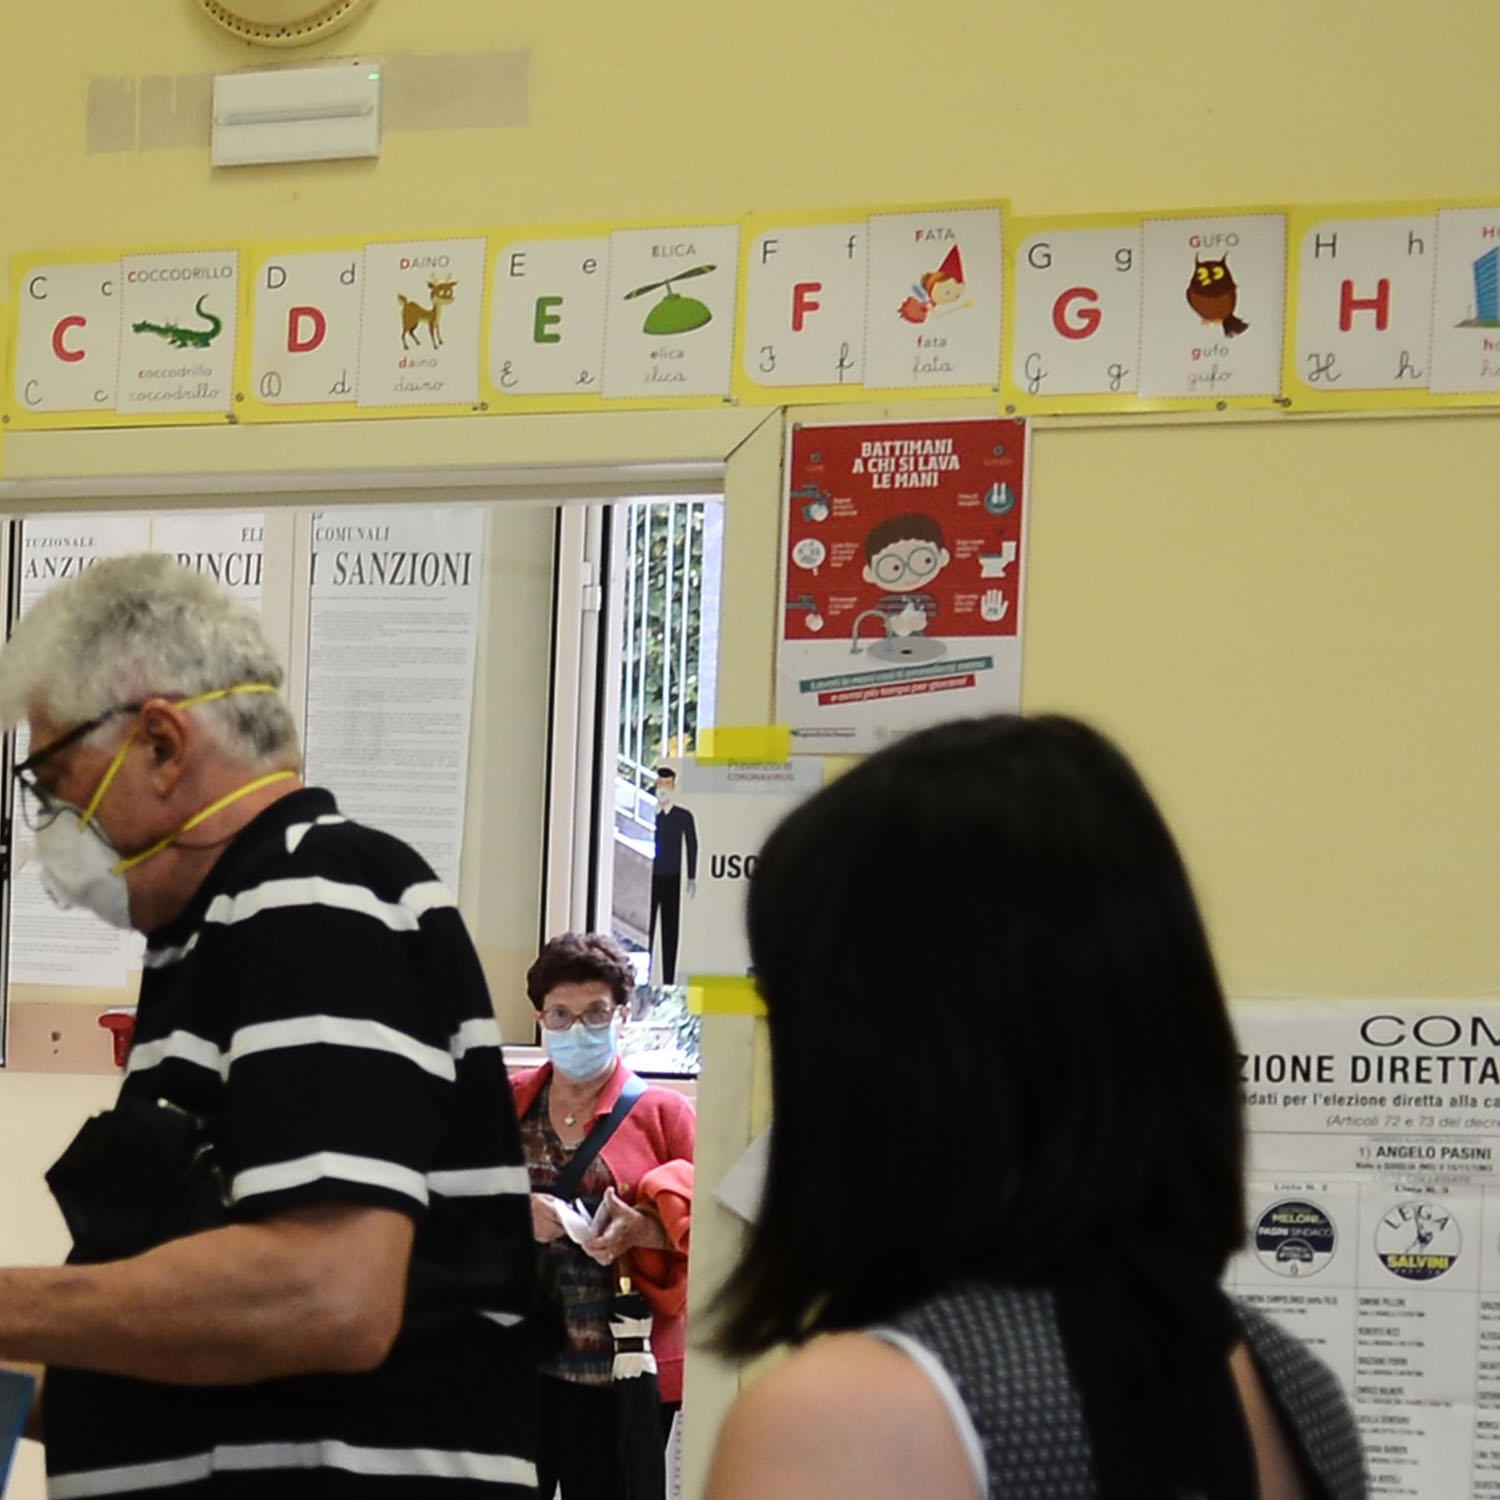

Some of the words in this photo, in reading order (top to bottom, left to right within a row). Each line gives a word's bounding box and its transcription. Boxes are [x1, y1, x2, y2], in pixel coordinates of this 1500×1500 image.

[915, 228, 955, 243] FATA
[1189, 233, 1239, 249] GUFO
[1314, 234, 1337, 259] H
[1407, 231, 1424, 256] h
[652, 244, 697, 259] ELICA
[762, 240, 778, 264] F
[845, 235, 856, 260] f
[1028, 243, 1052, 269] G
[1114, 247, 1133, 271] g
[400, 255, 451, 270] DAINO
[509, 253, 526, 278] E
[582, 257, 597, 274] e
[127, 266, 232, 284] COCCODRILLO
[267, 266, 286, 289] D
[340, 264, 355, 286] d
[29, 276, 48, 300] C
[101, 280, 113, 297] c
[792, 282, 821, 332] F
[1052, 286, 1101, 340] G
[1339, 278, 1390, 332] H
[287, 306, 326, 353] D
[533, 296, 563, 344] E
[52, 315, 87, 362] C
[917, 335, 947, 349] fata
[651, 347, 684, 360] elica
[1192, 343, 1229, 359] gufo
[138, 365, 212, 379] coccodrillo
[399, 356, 438, 370] daino
[861, 439, 953, 458] BATTIMANI
[852, 459, 864, 474] A
[868, 458, 895, 473] CHI
[900, 457, 915, 471] SI
[918, 455, 960, 470] LAVA
[872, 475, 891, 489] LE
[895, 472, 939, 488] MANI
[316, 527, 390, 542] COMUNALI
[333, 551, 472, 587] SANZIONI
[1351, 1055, 1500, 1085] DIRETTA
[1283, 1095, 1306, 1108] per
[1313, 1093, 1387, 1106] l'elezione
[1392, 1093, 1443, 1108] diretta
[1449, 1094, 1477, 1107] alla
[1384, 1115, 1401, 1126] 72
[1406, 1118, 1414, 1127] e
[1418, 1115, 1433, 1128] 73
[1439, 1116, 1459, 1128] del
[1376, 1146, 1436, 1160] ANGELO
[1441, 1147, 1492, 1160] PASINI
[1384, 1205, 1449, 1231] LEGA
[1387, 1255, 1449, 1269] SALVINI
